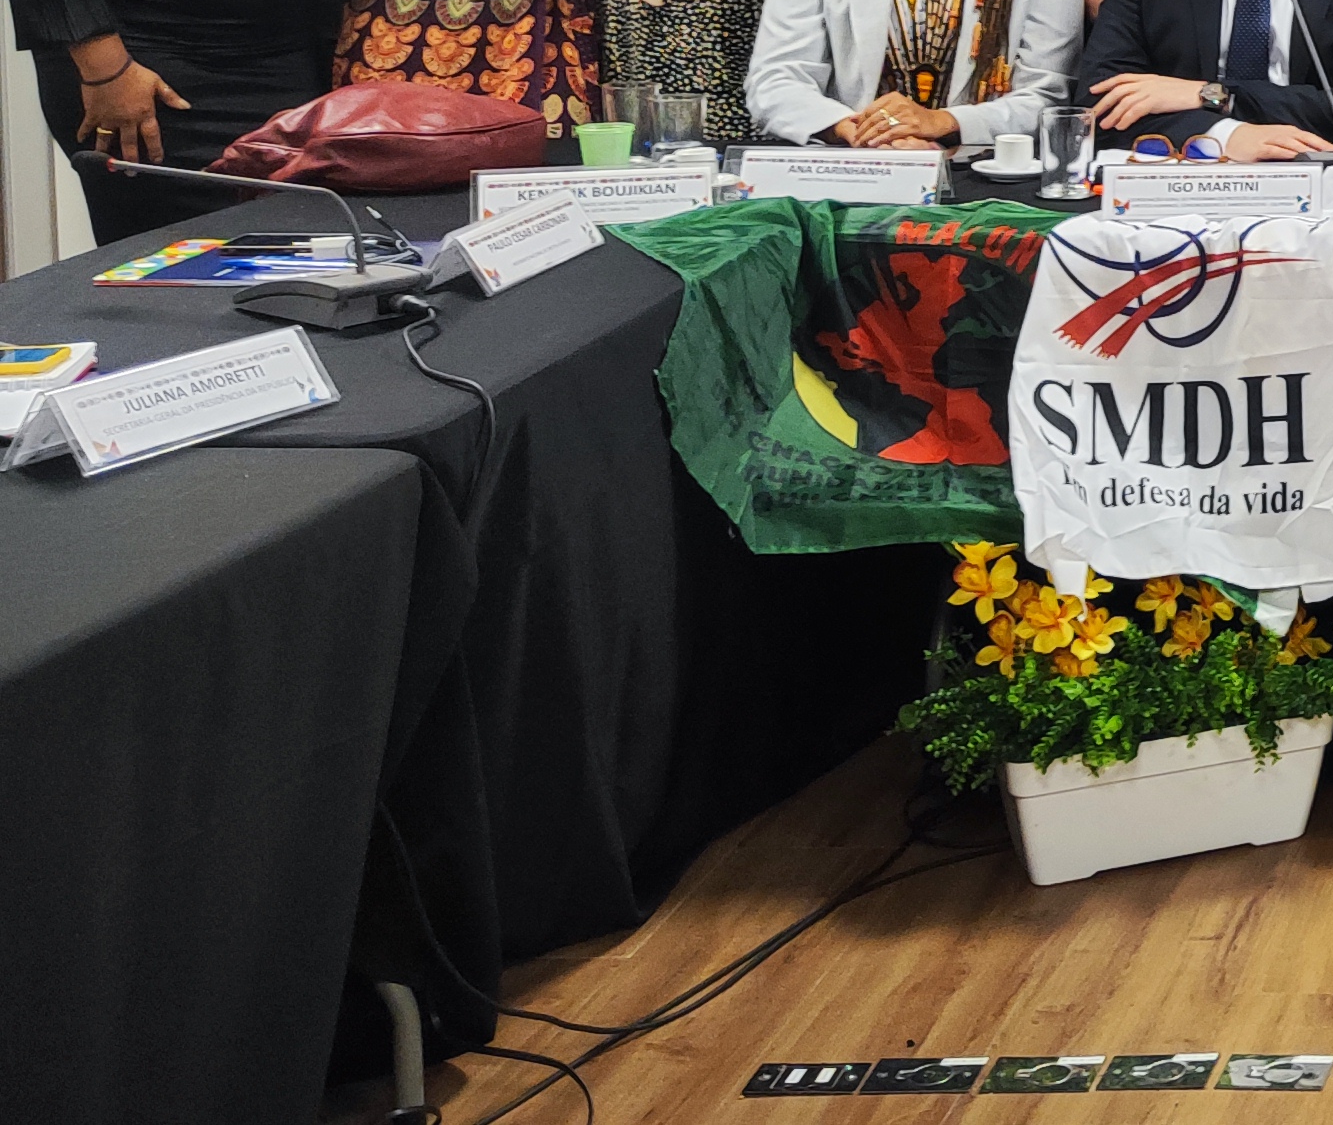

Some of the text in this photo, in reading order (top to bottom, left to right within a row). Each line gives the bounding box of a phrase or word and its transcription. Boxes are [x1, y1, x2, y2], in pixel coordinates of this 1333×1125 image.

[787, 164, 893, 177] ANA CARINHANHA
[592, 182, 677, 199] BOUJIKIAN
[1167, 180, 1259, 193] IGO MARTINI
[486, 236, 513, 254] PAULO
[122, 363, 267, 416] JULIANA AMORETTI
[1032, 372, 1315, 469] SMDH
[1100, 477, 1192, 508] defesa
[1199, 485, 1232, 516] da
[1243, 482, 1305, 515] vida
